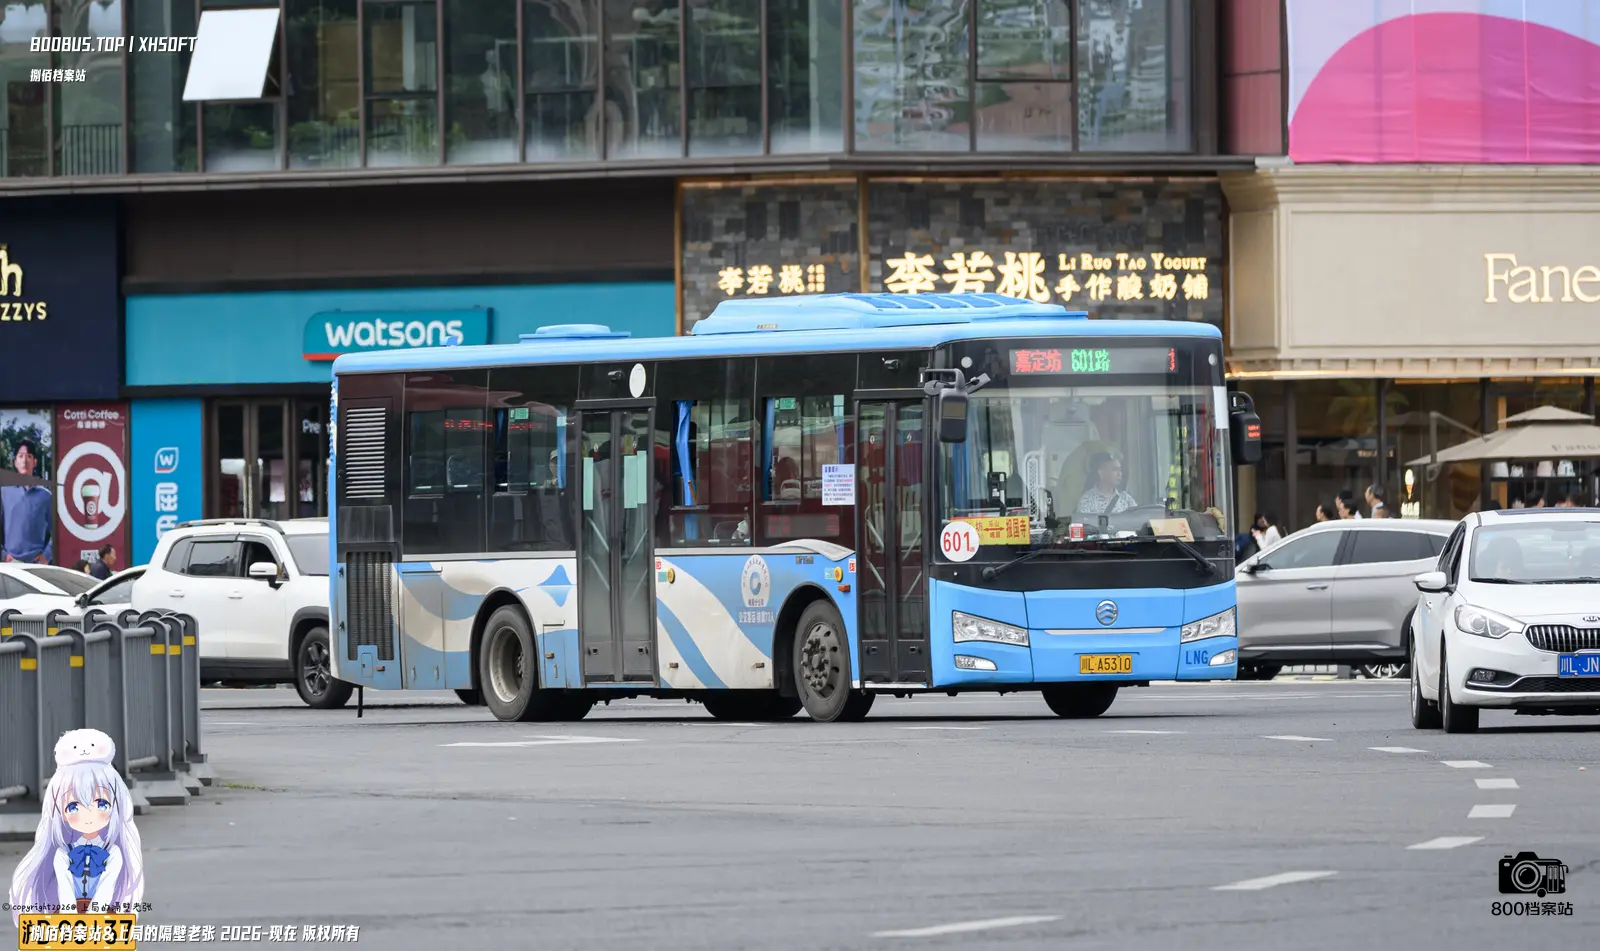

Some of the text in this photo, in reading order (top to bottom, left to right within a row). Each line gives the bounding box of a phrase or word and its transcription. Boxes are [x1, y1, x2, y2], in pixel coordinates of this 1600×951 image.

[718, 264, 805, 296] 李若桃
[884, 251, 1051, 303] 李若桃
[1484, 253, 1600, 303] Fane
[325, 318, 463, 347] watsons
[1015, 349, 1110, 373] 嘉定坊 601路
[1185, 650, 1208, 665] LNG
